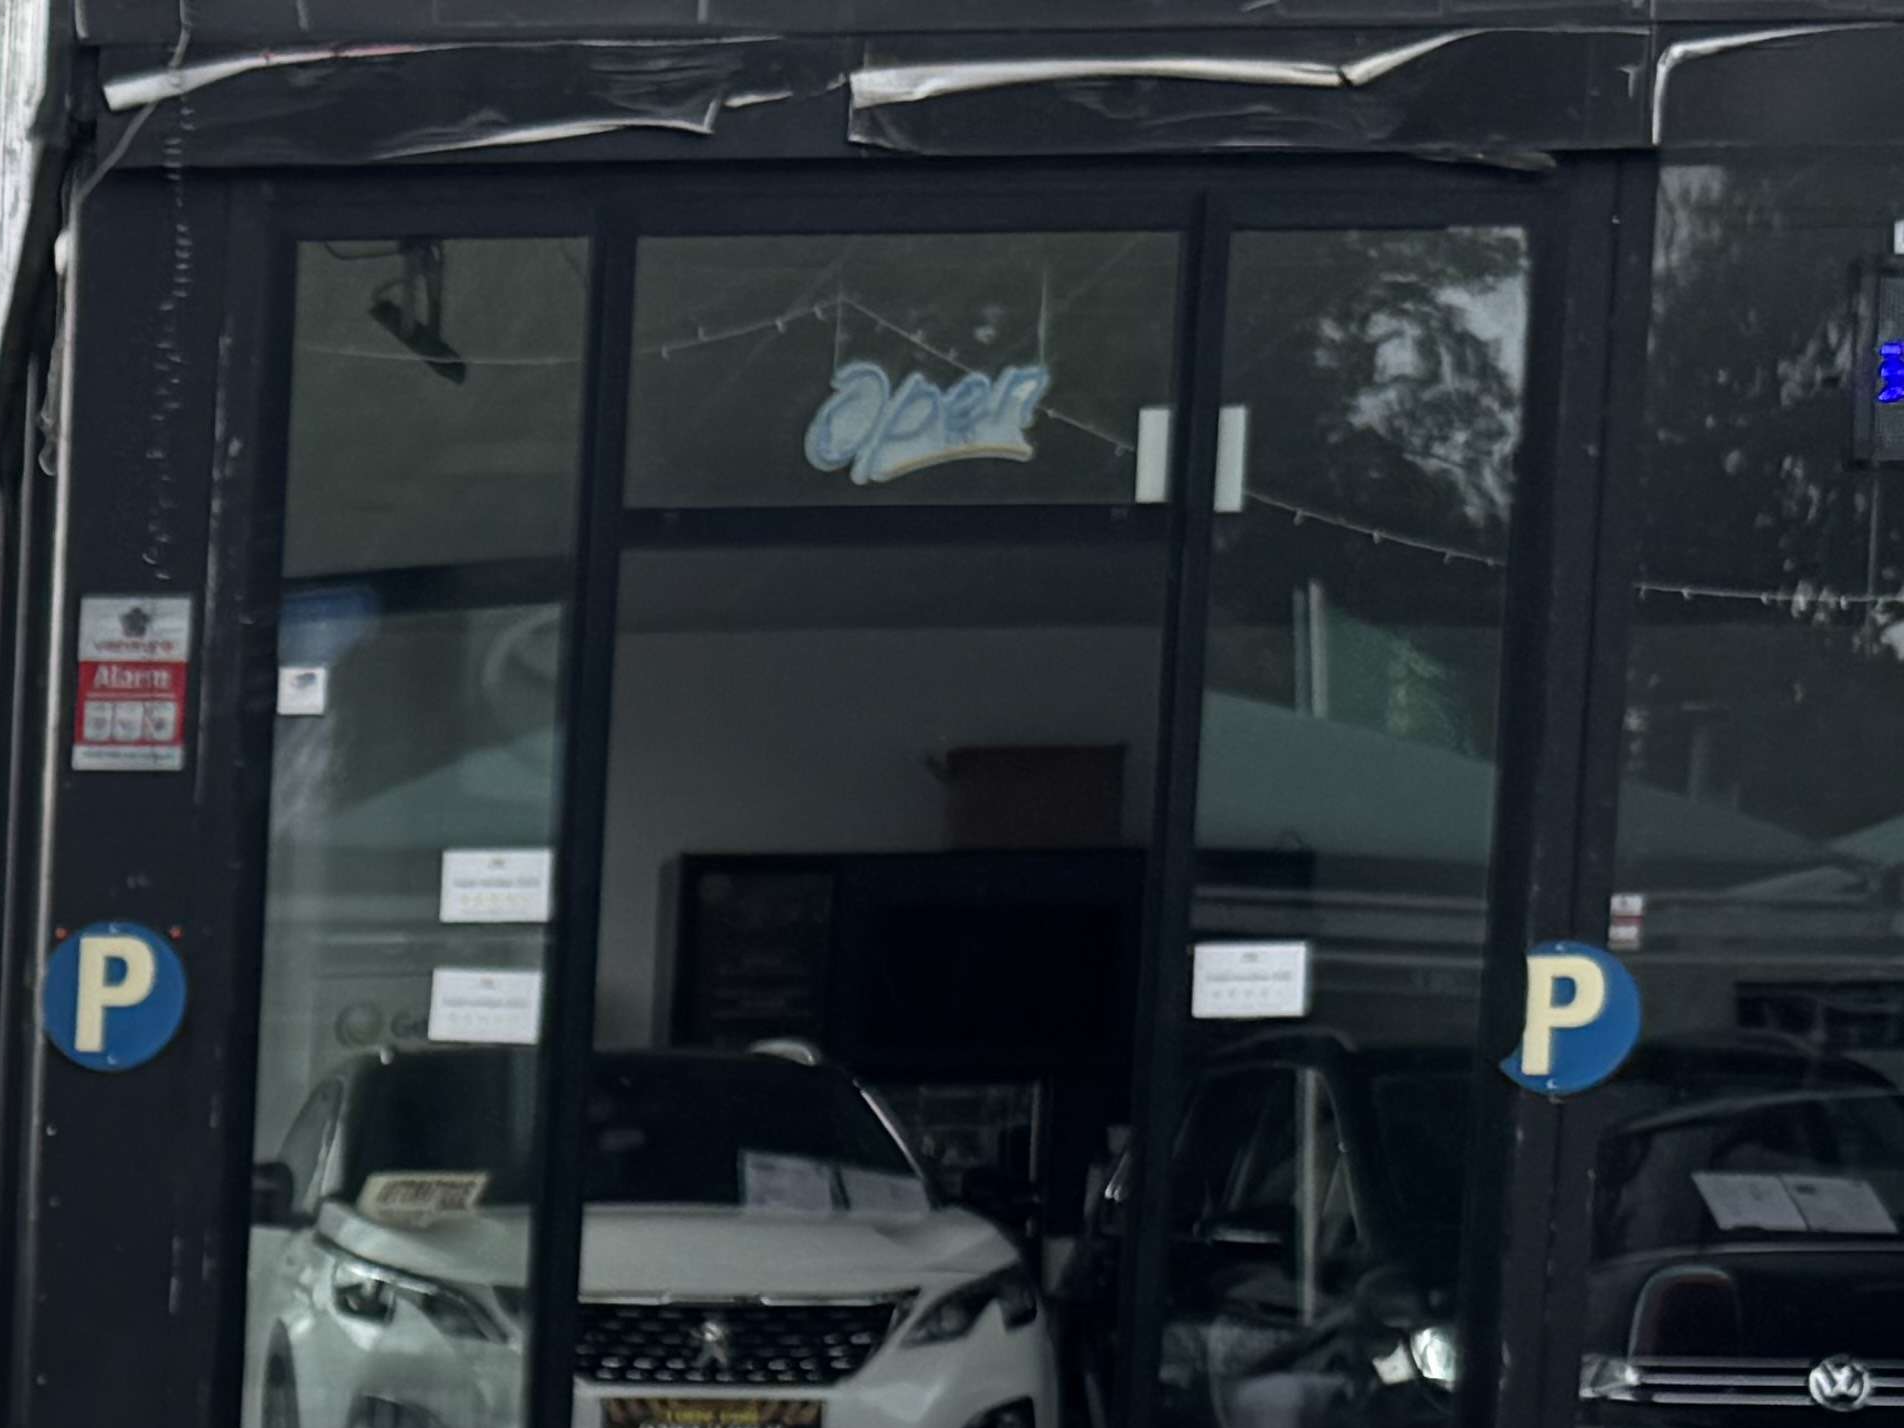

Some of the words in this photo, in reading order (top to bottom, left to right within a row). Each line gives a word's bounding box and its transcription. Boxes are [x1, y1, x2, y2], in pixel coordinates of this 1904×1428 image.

[804, 361, 1050, 485] Open
[93, 664, 172, 690] Alarm
[74, 934, 156, 1053] P
[1521, 954, 1607, 1077] P
